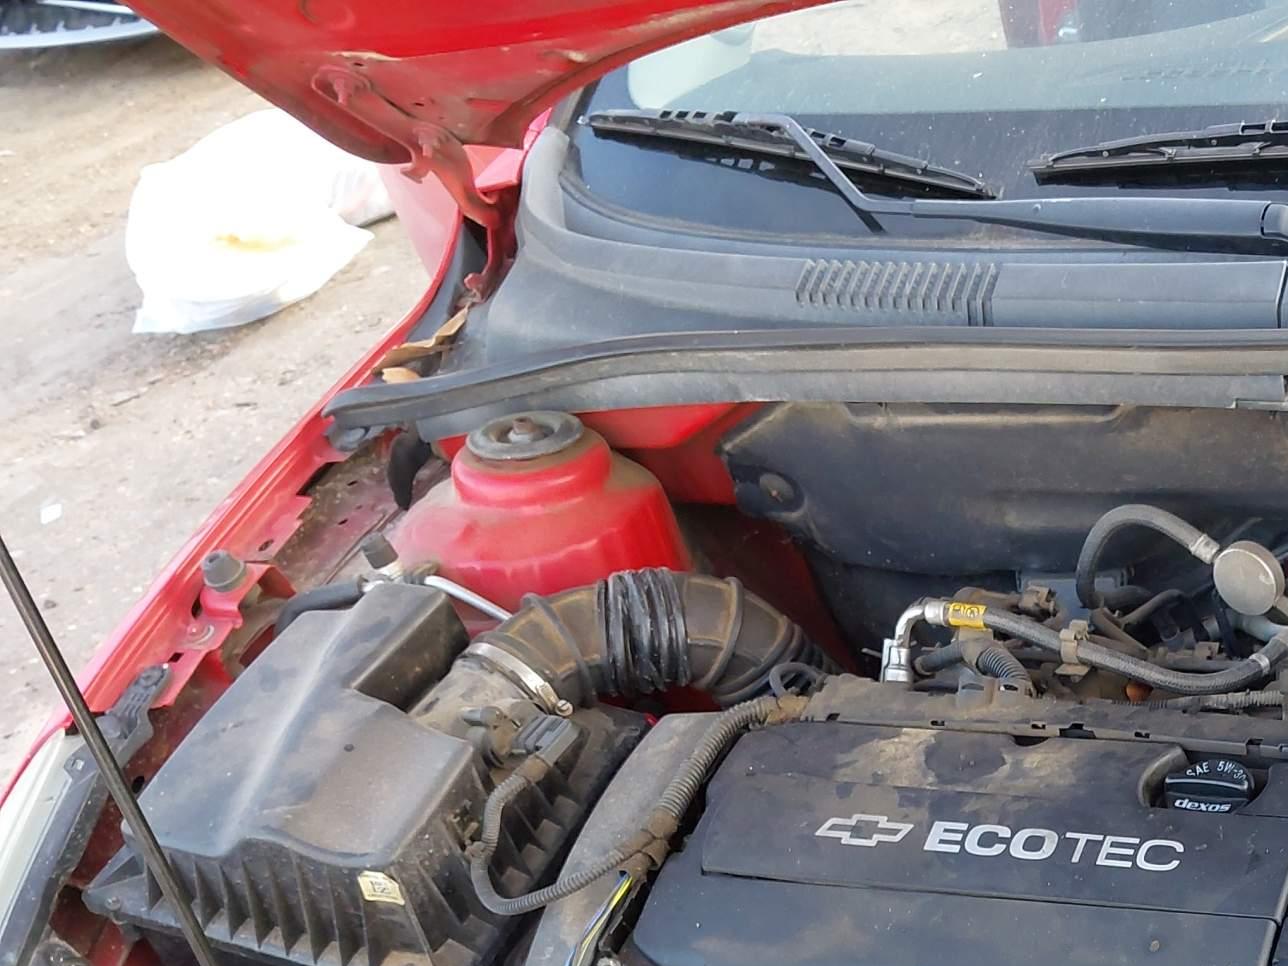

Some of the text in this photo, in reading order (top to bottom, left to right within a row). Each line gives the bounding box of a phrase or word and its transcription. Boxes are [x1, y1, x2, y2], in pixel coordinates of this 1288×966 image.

[1186, 761, 1210, 776] SAE
[1174, 798, 1232, 812] dexos
[923, 820, 1185, 872] ECOTEC
